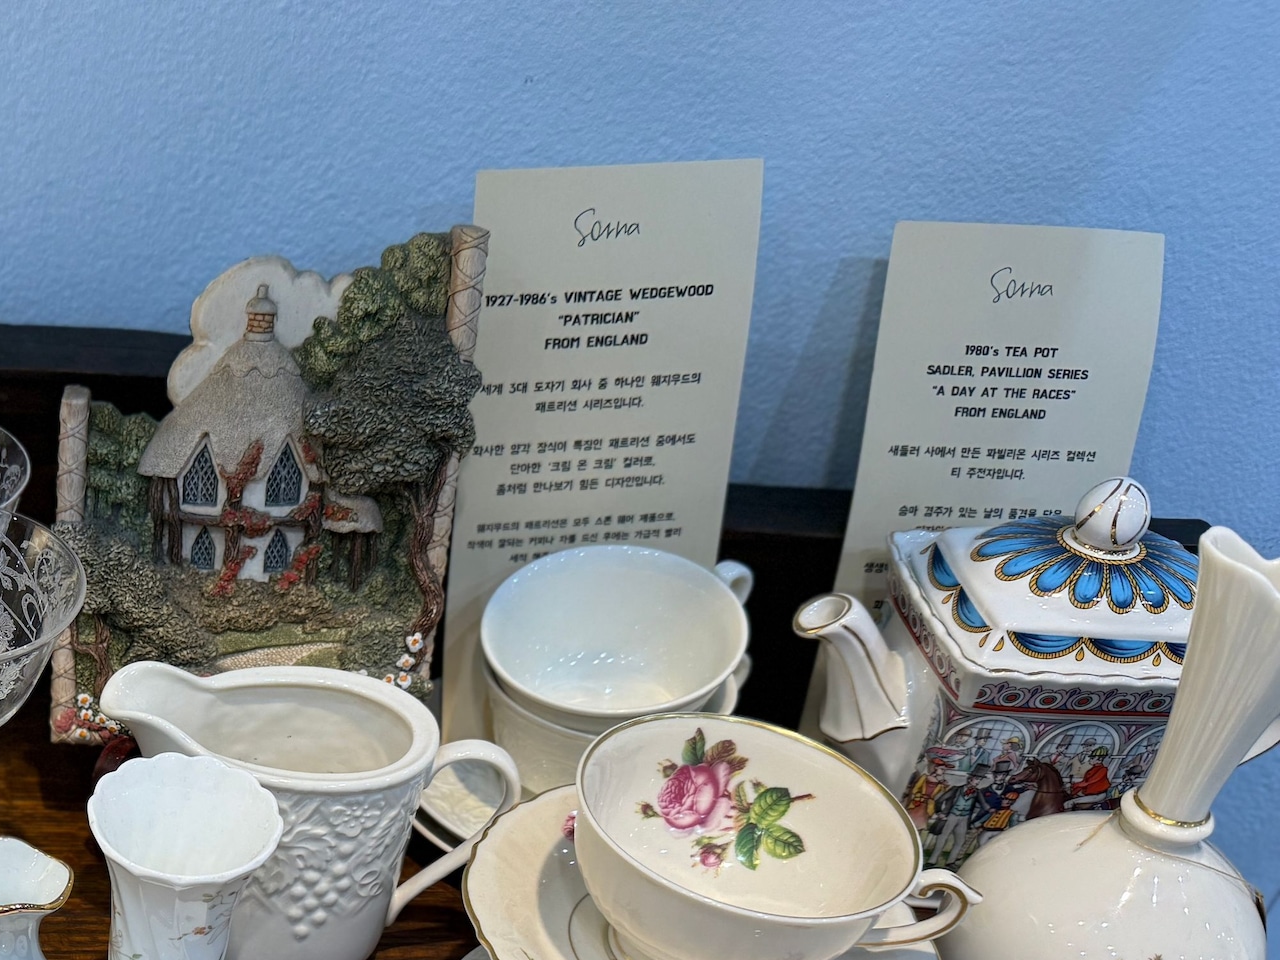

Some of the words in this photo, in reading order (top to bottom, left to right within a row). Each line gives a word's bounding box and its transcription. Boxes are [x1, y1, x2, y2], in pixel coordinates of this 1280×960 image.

[485, 292, 557, 307] 1927-1986's
[564, 289, 622, 304] VINTAGE
[629, 284, 714, 300] WEDGEWOOD
[558, 311, 640, 326] "PATRICIAN"
[544, 337, 580, 350] FROM
[587, 333, 648, 348] ENGLAND
[965, 345, 999, 356] 1980's
[1005, 346, 1027, 357] TEA
[1033, 347, 1058, 358] POT
[926, 365, 975, 377] SADLER,
[980, 366, 1042, 379] PAVILLION
[1047, 368, 1089, 380] SERIES
[508, 382, 527, 394] 3대
[533, 380, 565, 393] 도자기
[571, 378, 592, 392] 회사
[598, 377, 608, 390] 중
[614, 375, 645, 389] 하나인
[651, 372, 701, 387] 웨지우드의
[951, 386, 976, 397] DAY
[980, 387, 998, 398] AT
[1004, 387, 1027, 399] THE
[1032, 389, 1076, 400] RACES"
[535, 400, 577, 414] 패트리션
[583, 396, 644, 411] 시리즈입니다.
[954, 406, 986, 418] FROM
[991, 408, 1046, 420] ENGLAND
[510, 443, 530, 456] 양각
[536, 440, 567, 454] 장식이
[573, 438, 602, 451] 특징인
[608, 435, 650, 450] 패트리션
[655, 433, 696, 447] 중에서도
[887, 444, 920, 457] 새들러
[924, 446, 956, 458] 사에서
[960, 447, 981, 459] 만든
[985, 447, 1026, 461] 파빌리온
[1031, 449, 1060, 461] 시리즈
[1066, 450, 1096, 462] 컬렉션
[510, 462, 541, 475] 단아한
[577, 459, 587, 471] 온
[950, 467, 961, 478] 티
[966, 467, 1025, 480] 주전자입니다.
[496, 483, 527, 496] 좀처럼
[533, 480, 573, 493] 만나보기
[579, 478, 599, 490] 힘든
[605, 475, 665, 488] 디자인입니다.
[898, 505, 918, 516] 승마
[924, 506, 953, 518] 경주가
[958, 507, 978, 519] 있는
[983, 508, 1003, 519] 날의
